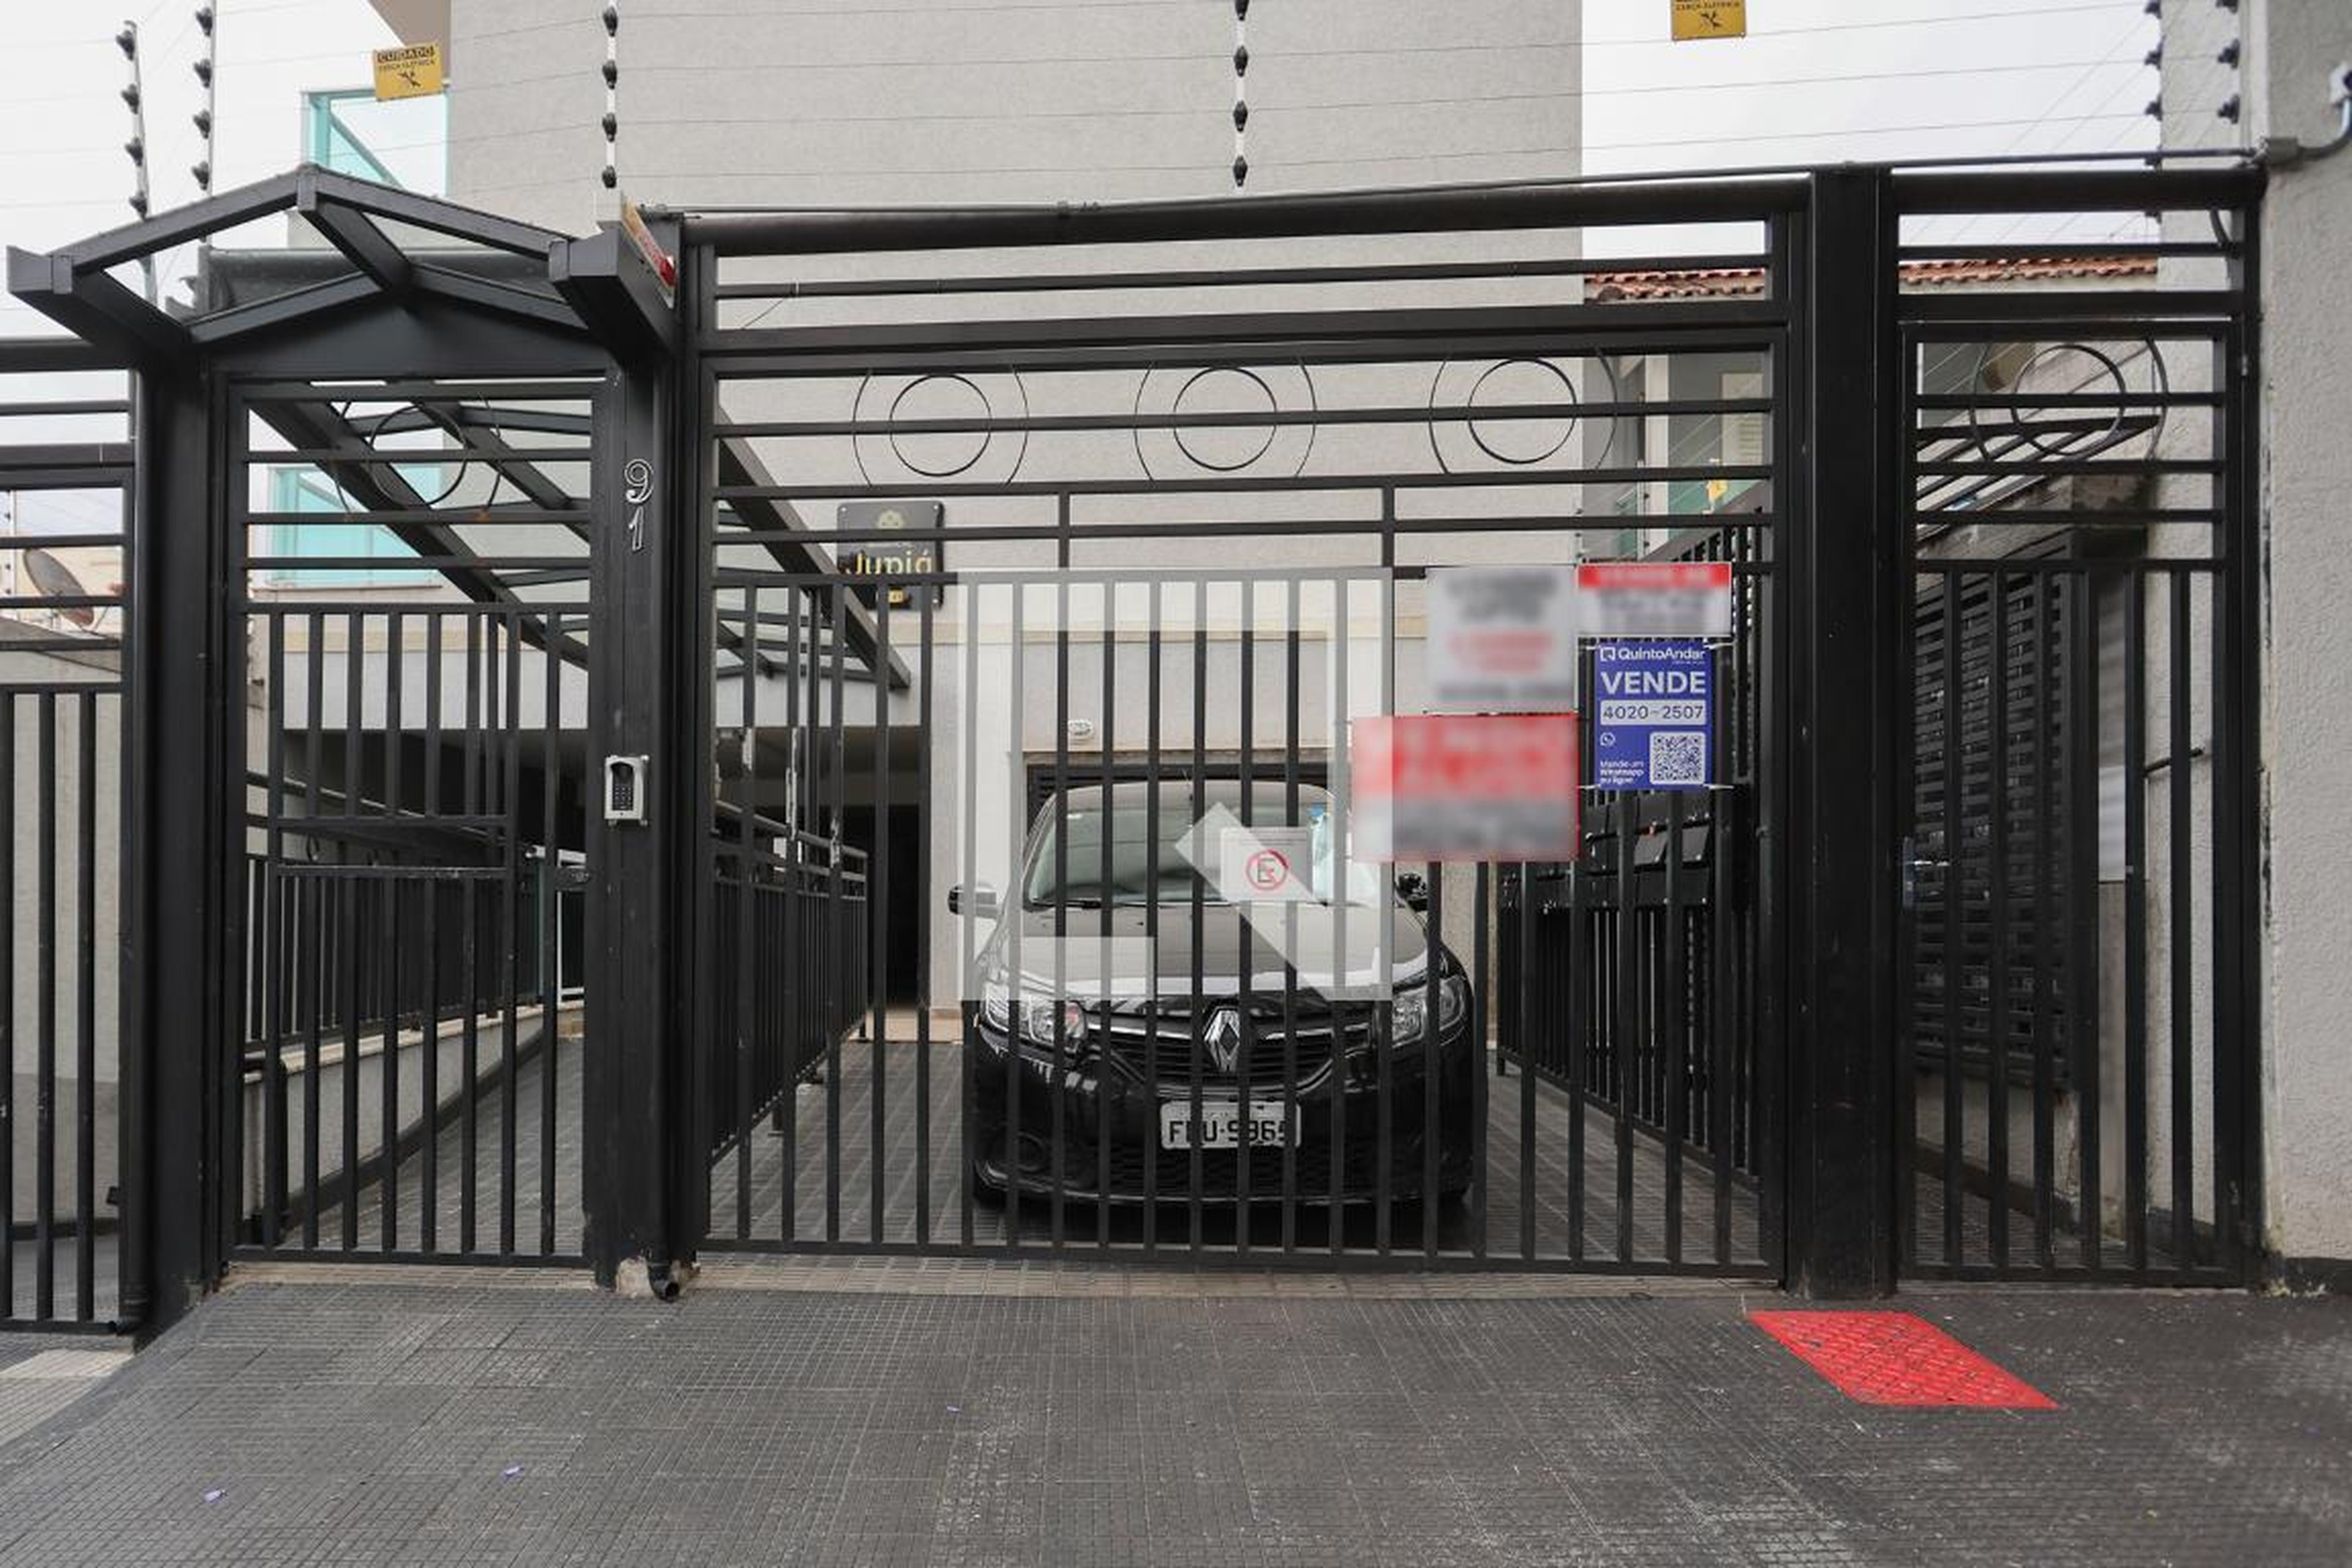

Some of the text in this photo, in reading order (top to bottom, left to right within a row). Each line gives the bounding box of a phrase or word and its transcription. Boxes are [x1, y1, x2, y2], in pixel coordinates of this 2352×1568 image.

[377, 46, 434, 63] CUIDADO
[624, 458, 654, 551] 91
[1618, 647, 1705, 661] QuintoAndar
[1600, 671, 1706, 694] VENDE
[1602, 705, 1703, 720] 4020-2507
